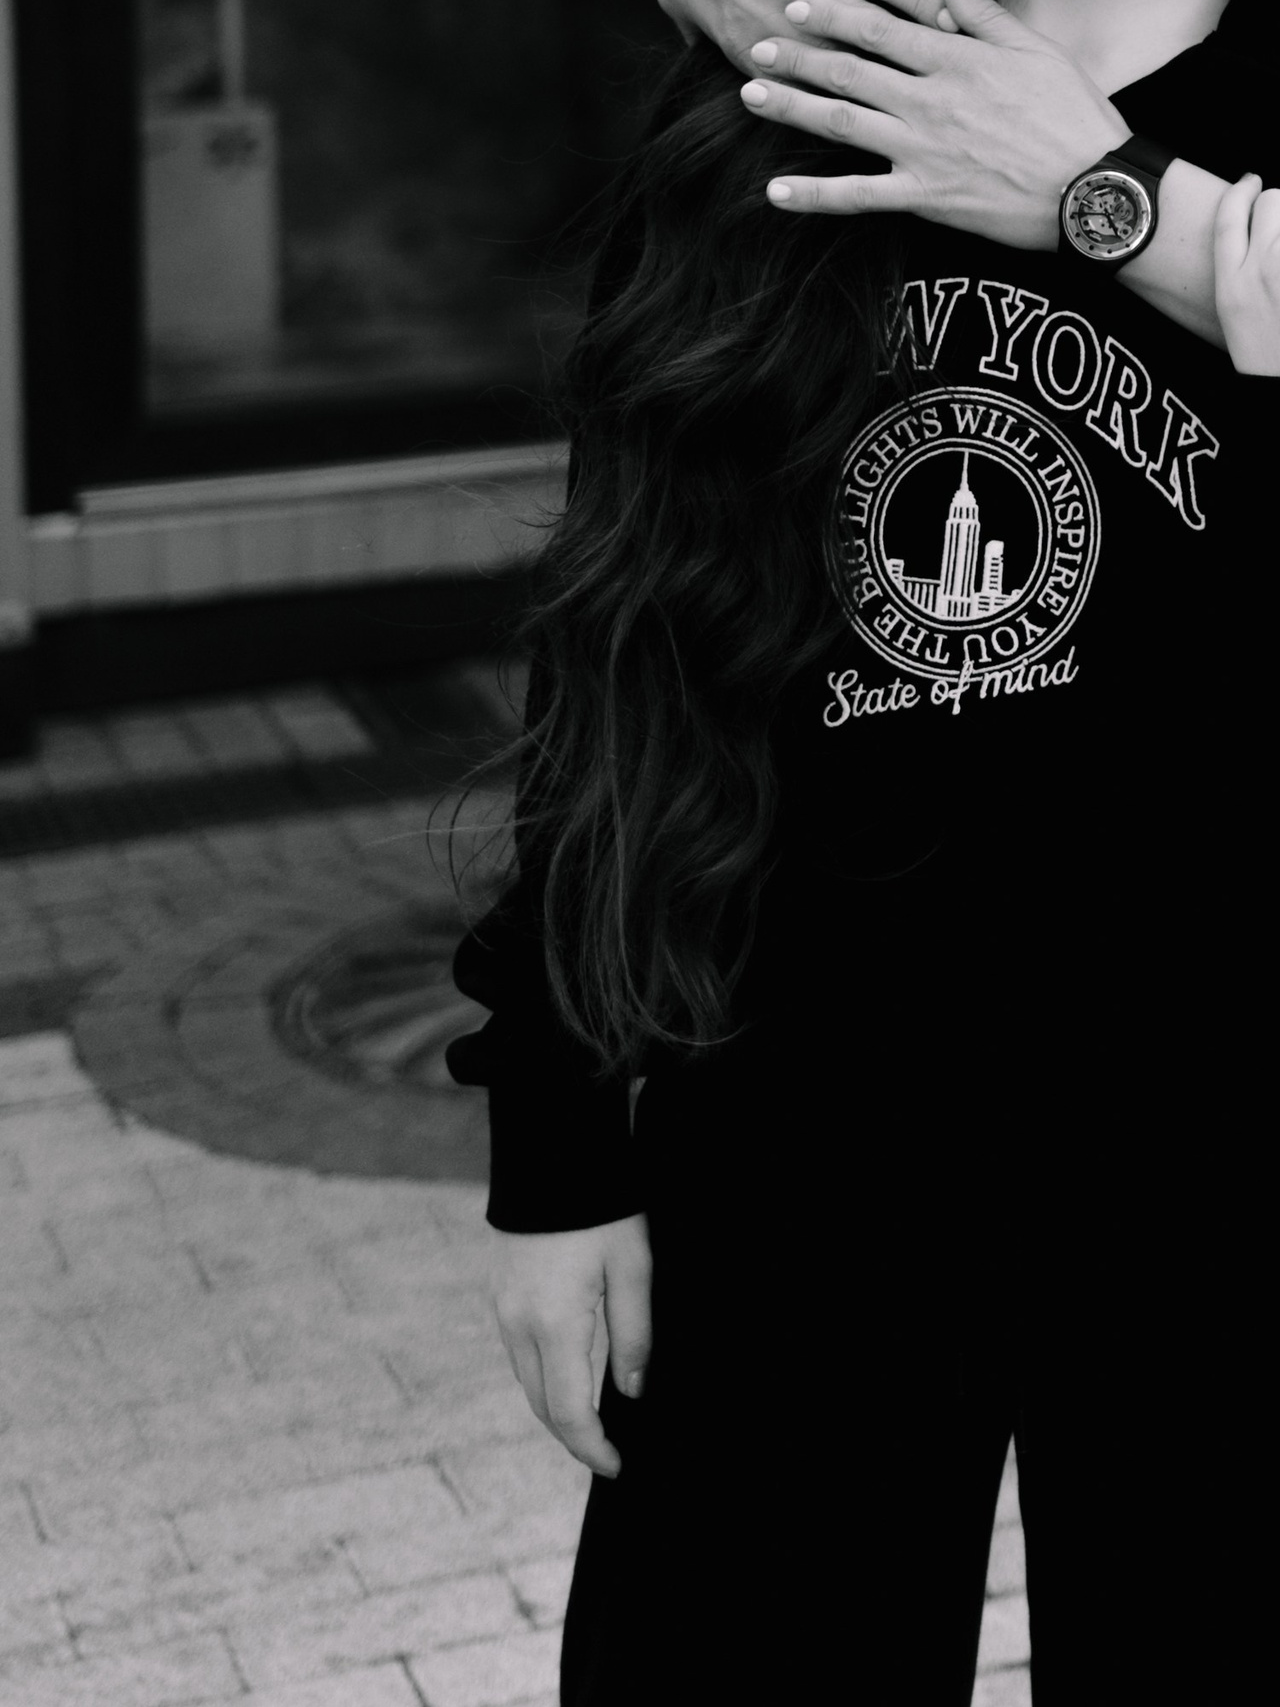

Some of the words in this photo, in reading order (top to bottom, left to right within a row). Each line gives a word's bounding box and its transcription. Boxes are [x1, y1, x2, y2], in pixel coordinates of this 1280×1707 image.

[950, 403, 1041, 463] WILL
[977, 279, 1220, 531] YORK
[840, 407, 943, 528] LIGHTS
[1037, 454, 1086, 617] INSPIRE
[873, 603, 951, 664] THE
[963, 612, 1048, 663] YOU
[823, 668, 921, 728] State
[931, 660, 974, 716] of
[979, 645, 1080, 700] mind
